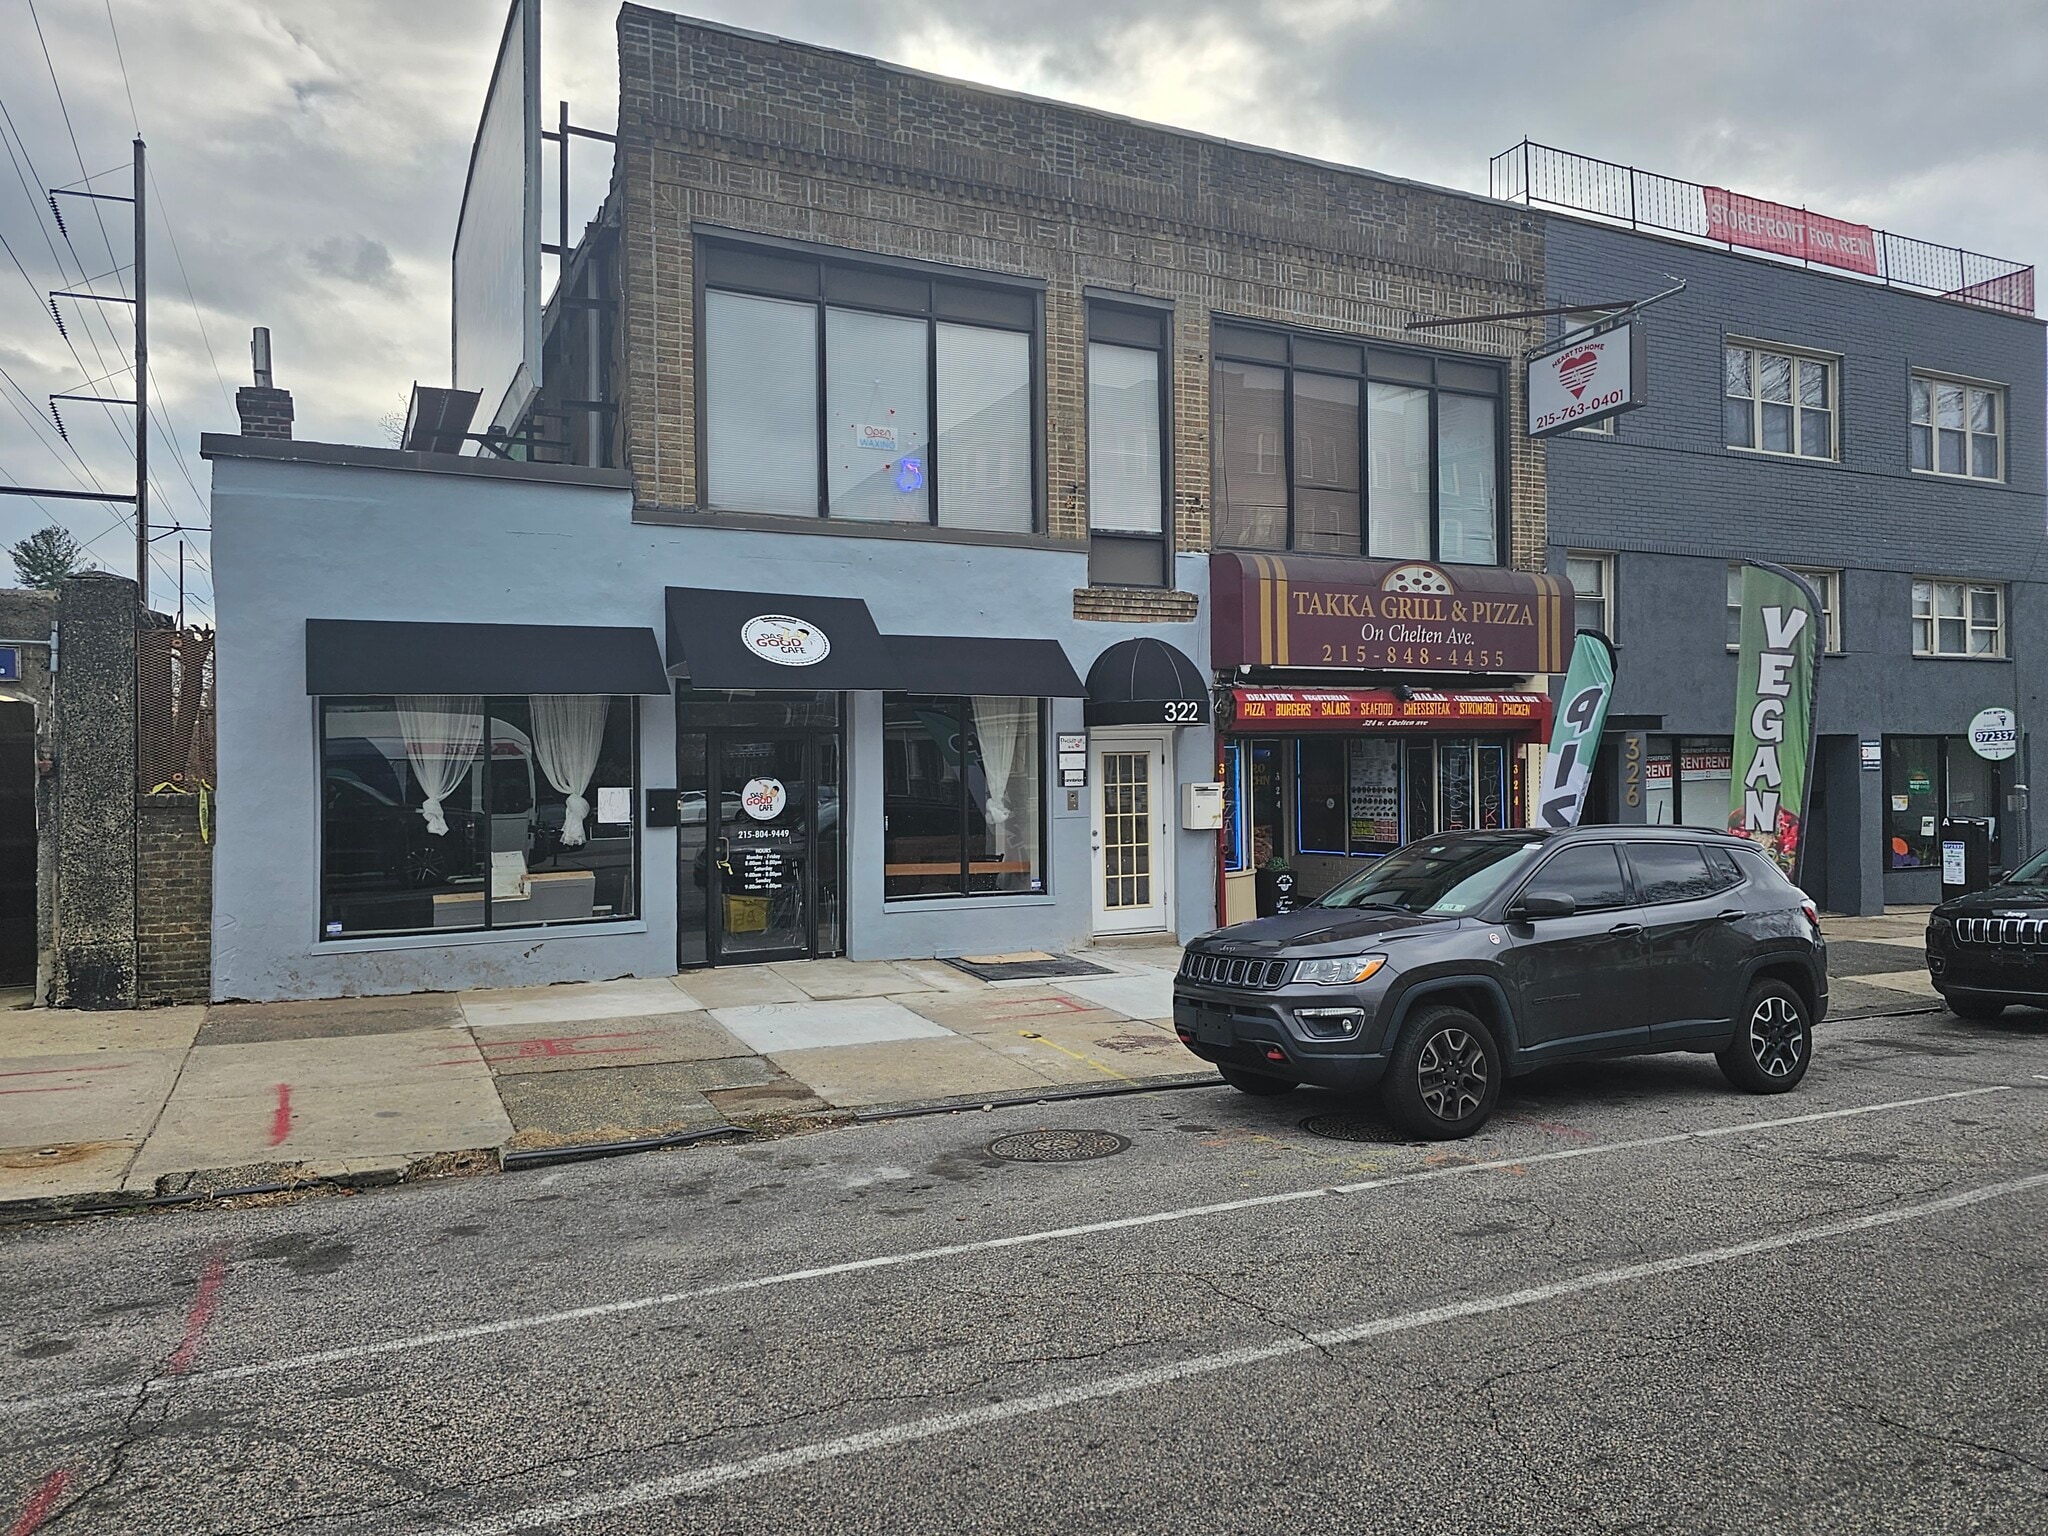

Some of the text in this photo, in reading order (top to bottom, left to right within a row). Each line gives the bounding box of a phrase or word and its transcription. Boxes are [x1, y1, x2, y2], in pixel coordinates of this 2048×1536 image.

[1711, 203, 1872, 259] STOREFRONT FOR RENT
[1552, 343, 1605, 369] HEART TO HOME
[1536, 389, 1624, 430] 215-763-0401
[864, 426, 891, 437] Open
[860, 438, 896, 449] WAXING
[1293, 591, 1535, 626] TAKKA GRILL & PIZZA
[1361, 623, 1475, 646] On Chelten Ave.
[756, 638, 802, 647] GOOD
[780, 646, 807, 654] CAFE
[1322, 644, 1505, 667] 215-848-4455
[1245, 693, 1295, 701] DELIVERY
[1413, 692, 1448, 702] HALAL
[1164, 702, 1198, 722] 322
[1244, 703, 1266, 716] PIZZA
[1275, 703, 1311, 716] BURGERS
[1321, 702, 1351, 715] SALADS
[1360, 703, 1394, 716] SEAFOOD
[1403, 703, 1451, 715] CHEESESTEAK
[1502, 703, 1531, 716] CHICKEN
[1744, 606, 1808, 833] VEGAN
[1976, 731, 2015, 742] 972337
[1681, 756, 1730, 769] RENT RENT
[1625, 738, 1641, 808] 326
[1646, 763, 1671, 777] RENT
[747, 795, 772, 805] GOOD
[738, 829, 790, 839] 215-804-9449
